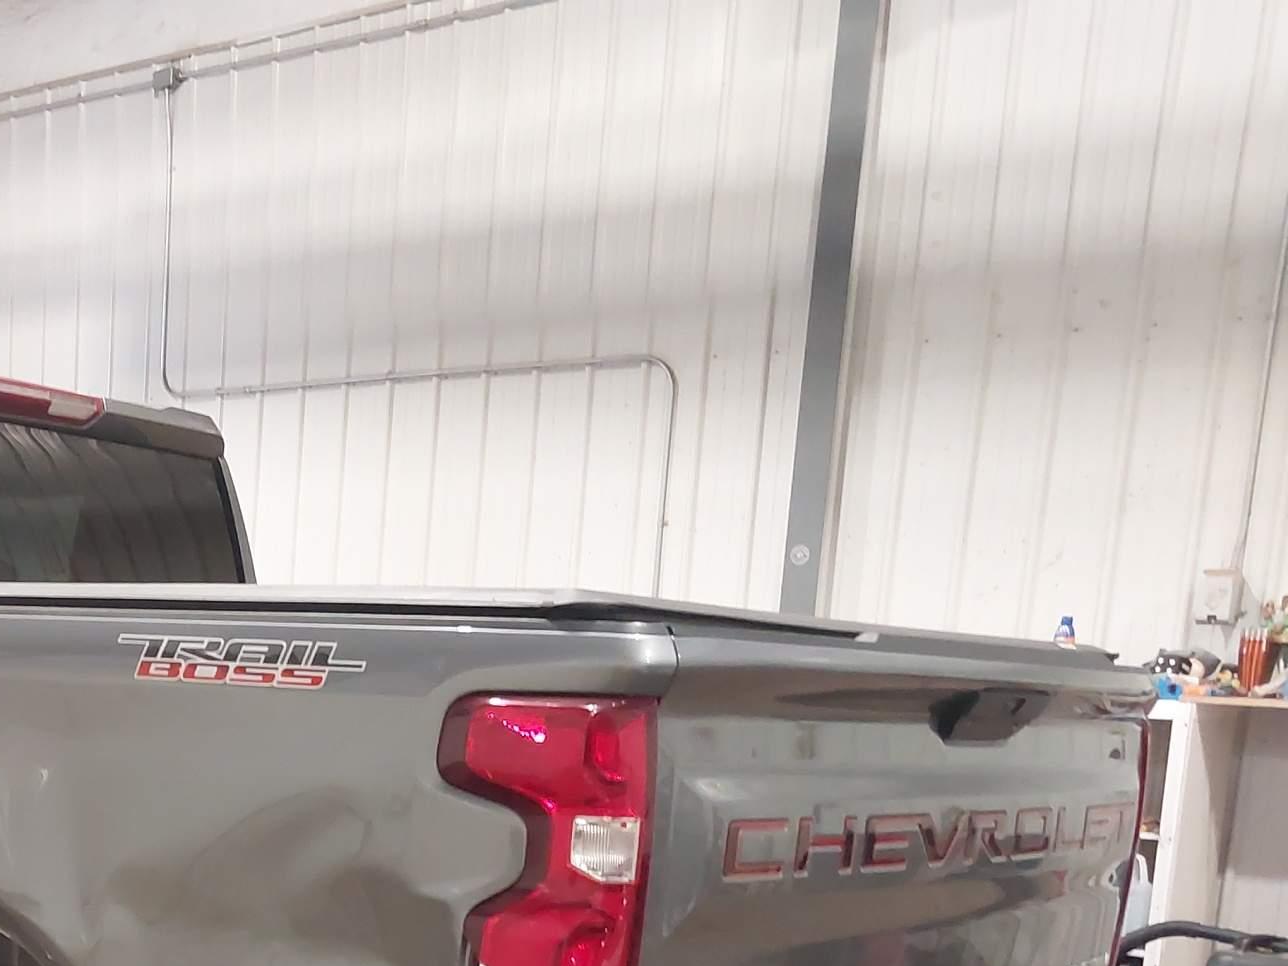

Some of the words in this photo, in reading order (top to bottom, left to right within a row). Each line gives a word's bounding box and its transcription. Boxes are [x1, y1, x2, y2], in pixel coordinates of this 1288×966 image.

[118, 633, 367, 673] TRAIL
[134, 659, 329, 690] BOSS
[722, 802, 1136, 883] CHEVROLET
